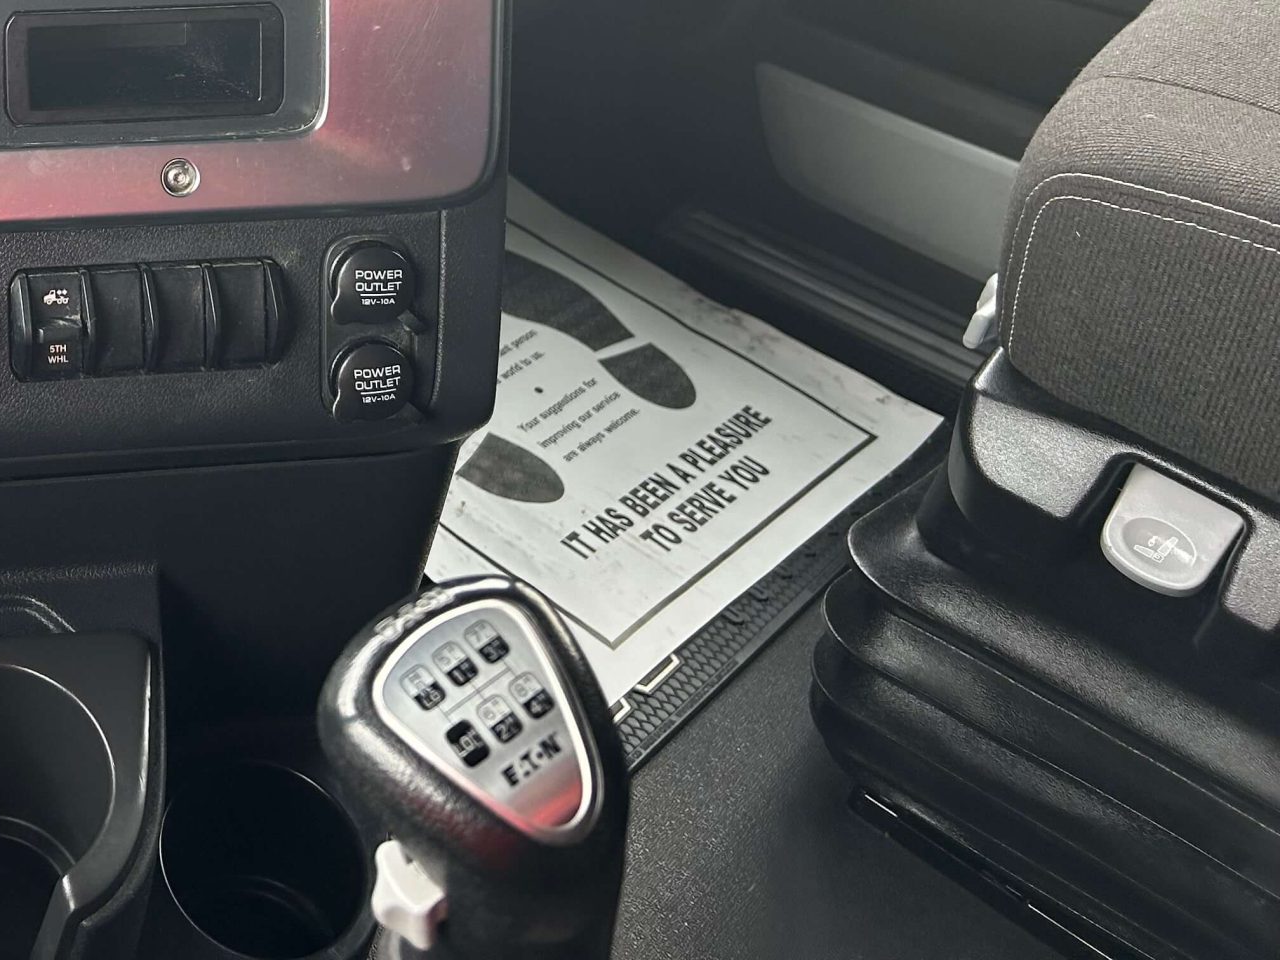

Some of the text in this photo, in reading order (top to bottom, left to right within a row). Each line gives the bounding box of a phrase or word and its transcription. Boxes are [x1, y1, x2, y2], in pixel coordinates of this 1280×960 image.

[355, 269, 403, 280] POWER
[355, 281, 402, 292] OUTLET
[361, 297, 396, 305] 12V-10A
[49, 343, 67, 354] 5TH
[47, 354, 69, 364] WHL
[353, 364, 401, 379] POWER
[354, 376, 401, 390] OUTLET
[362, 394, 396, 404] 12V-10A
[517, 377, 598, 432] Your suggestions for
[536, 390, 621, 449] improving our service
[562, 449, 579, 462] are
[577, 431, 606, 452] always
[560, 405, 772, 560] IT HAS BEEN A PLEASURE
[639, 455, 770, 552] TO SERVE YOU
